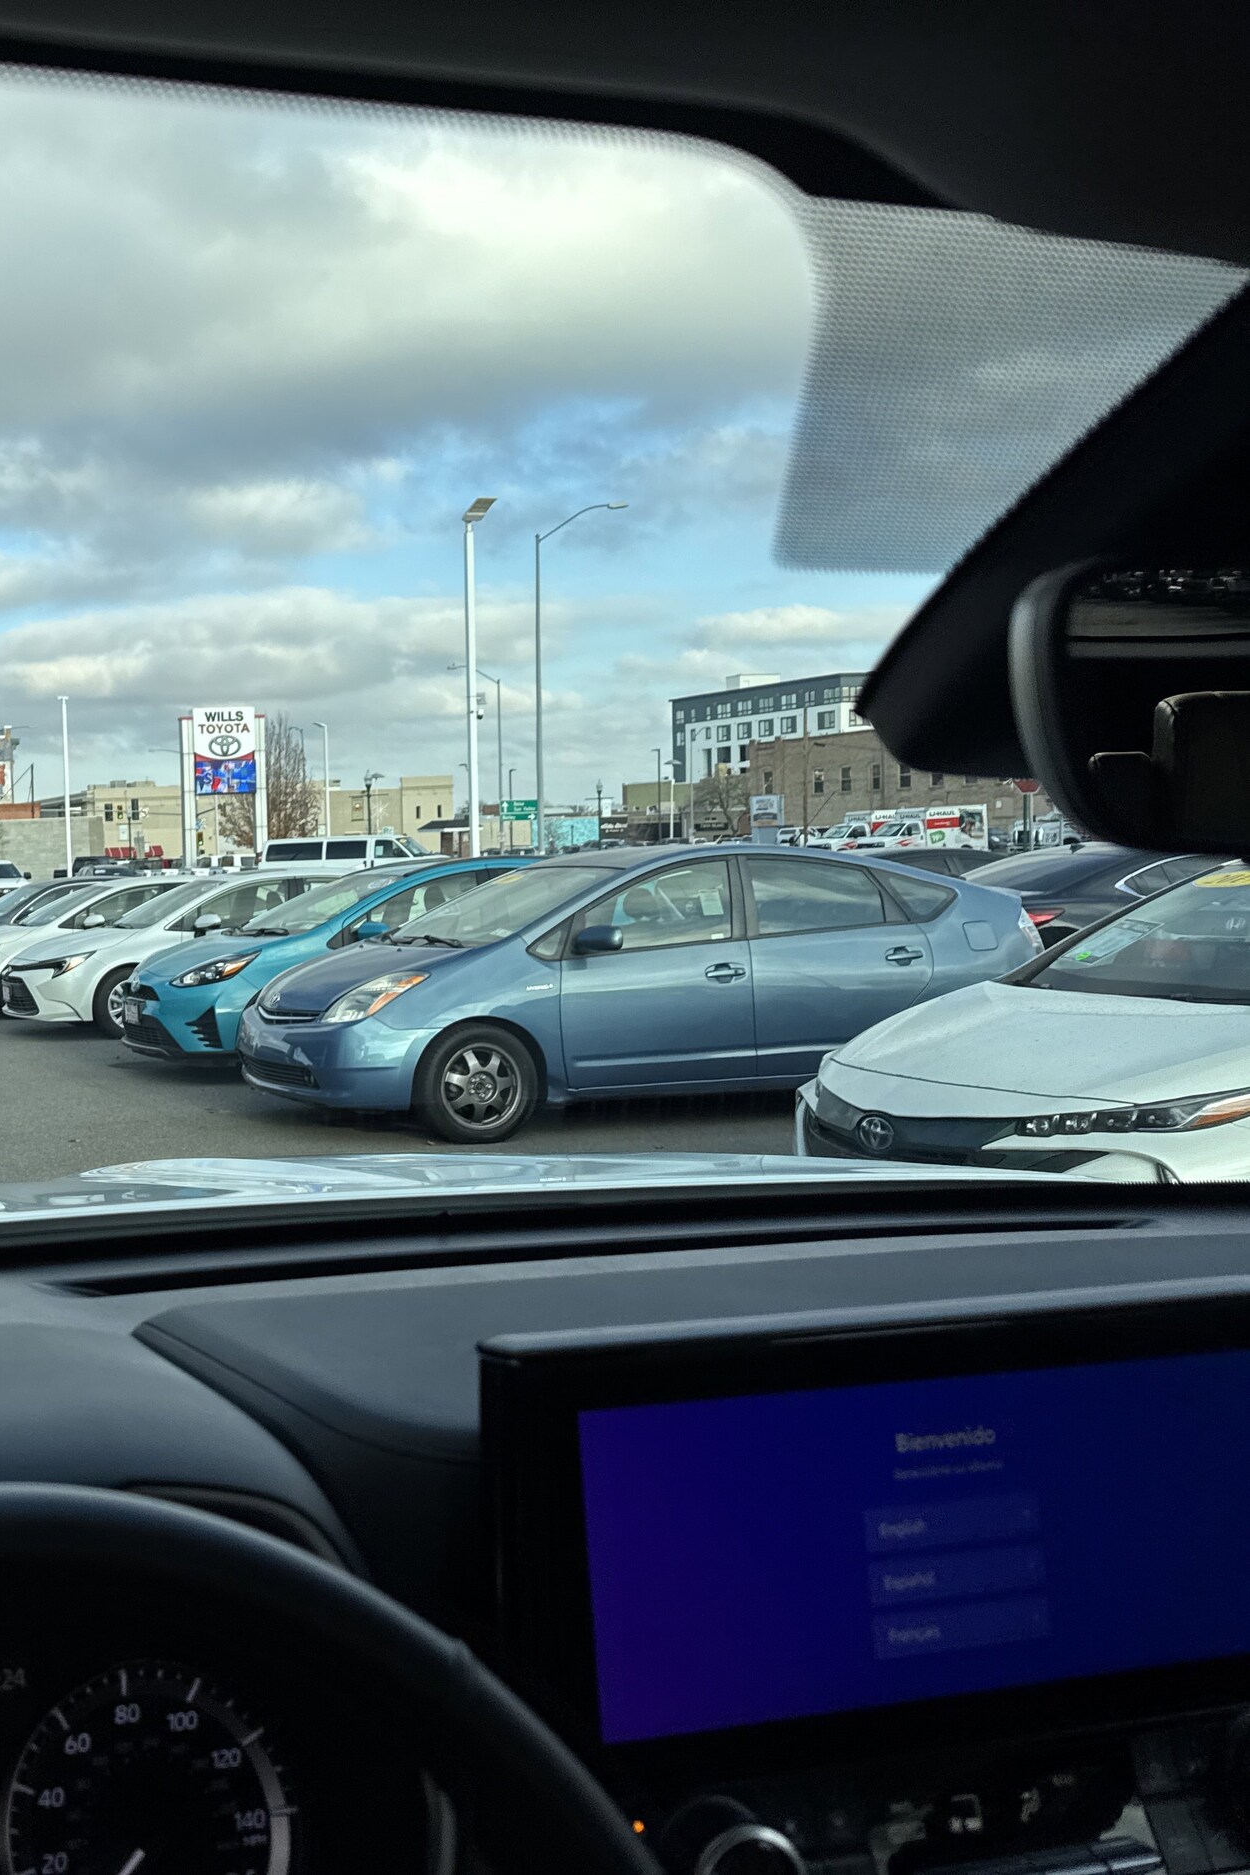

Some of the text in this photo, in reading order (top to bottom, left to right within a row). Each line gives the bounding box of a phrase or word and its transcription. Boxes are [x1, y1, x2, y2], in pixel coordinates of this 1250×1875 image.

[205, 711, 243, 722] WILLS
[198, 723, 250, 734] TOYOTA
[895, 1426, 996, 1454] Bienvenido
[113, 1703, 142, 1725] 80
[166, 1710, 200, 1733] 100
[64, 1732, 92, 1755] 60
[211, 1748, 242, 1769] 120
[37, 1786, 65, 1808] 40
[234, 1808, 268, 1831] 140
[42, 1851, 68, 1875] 20
